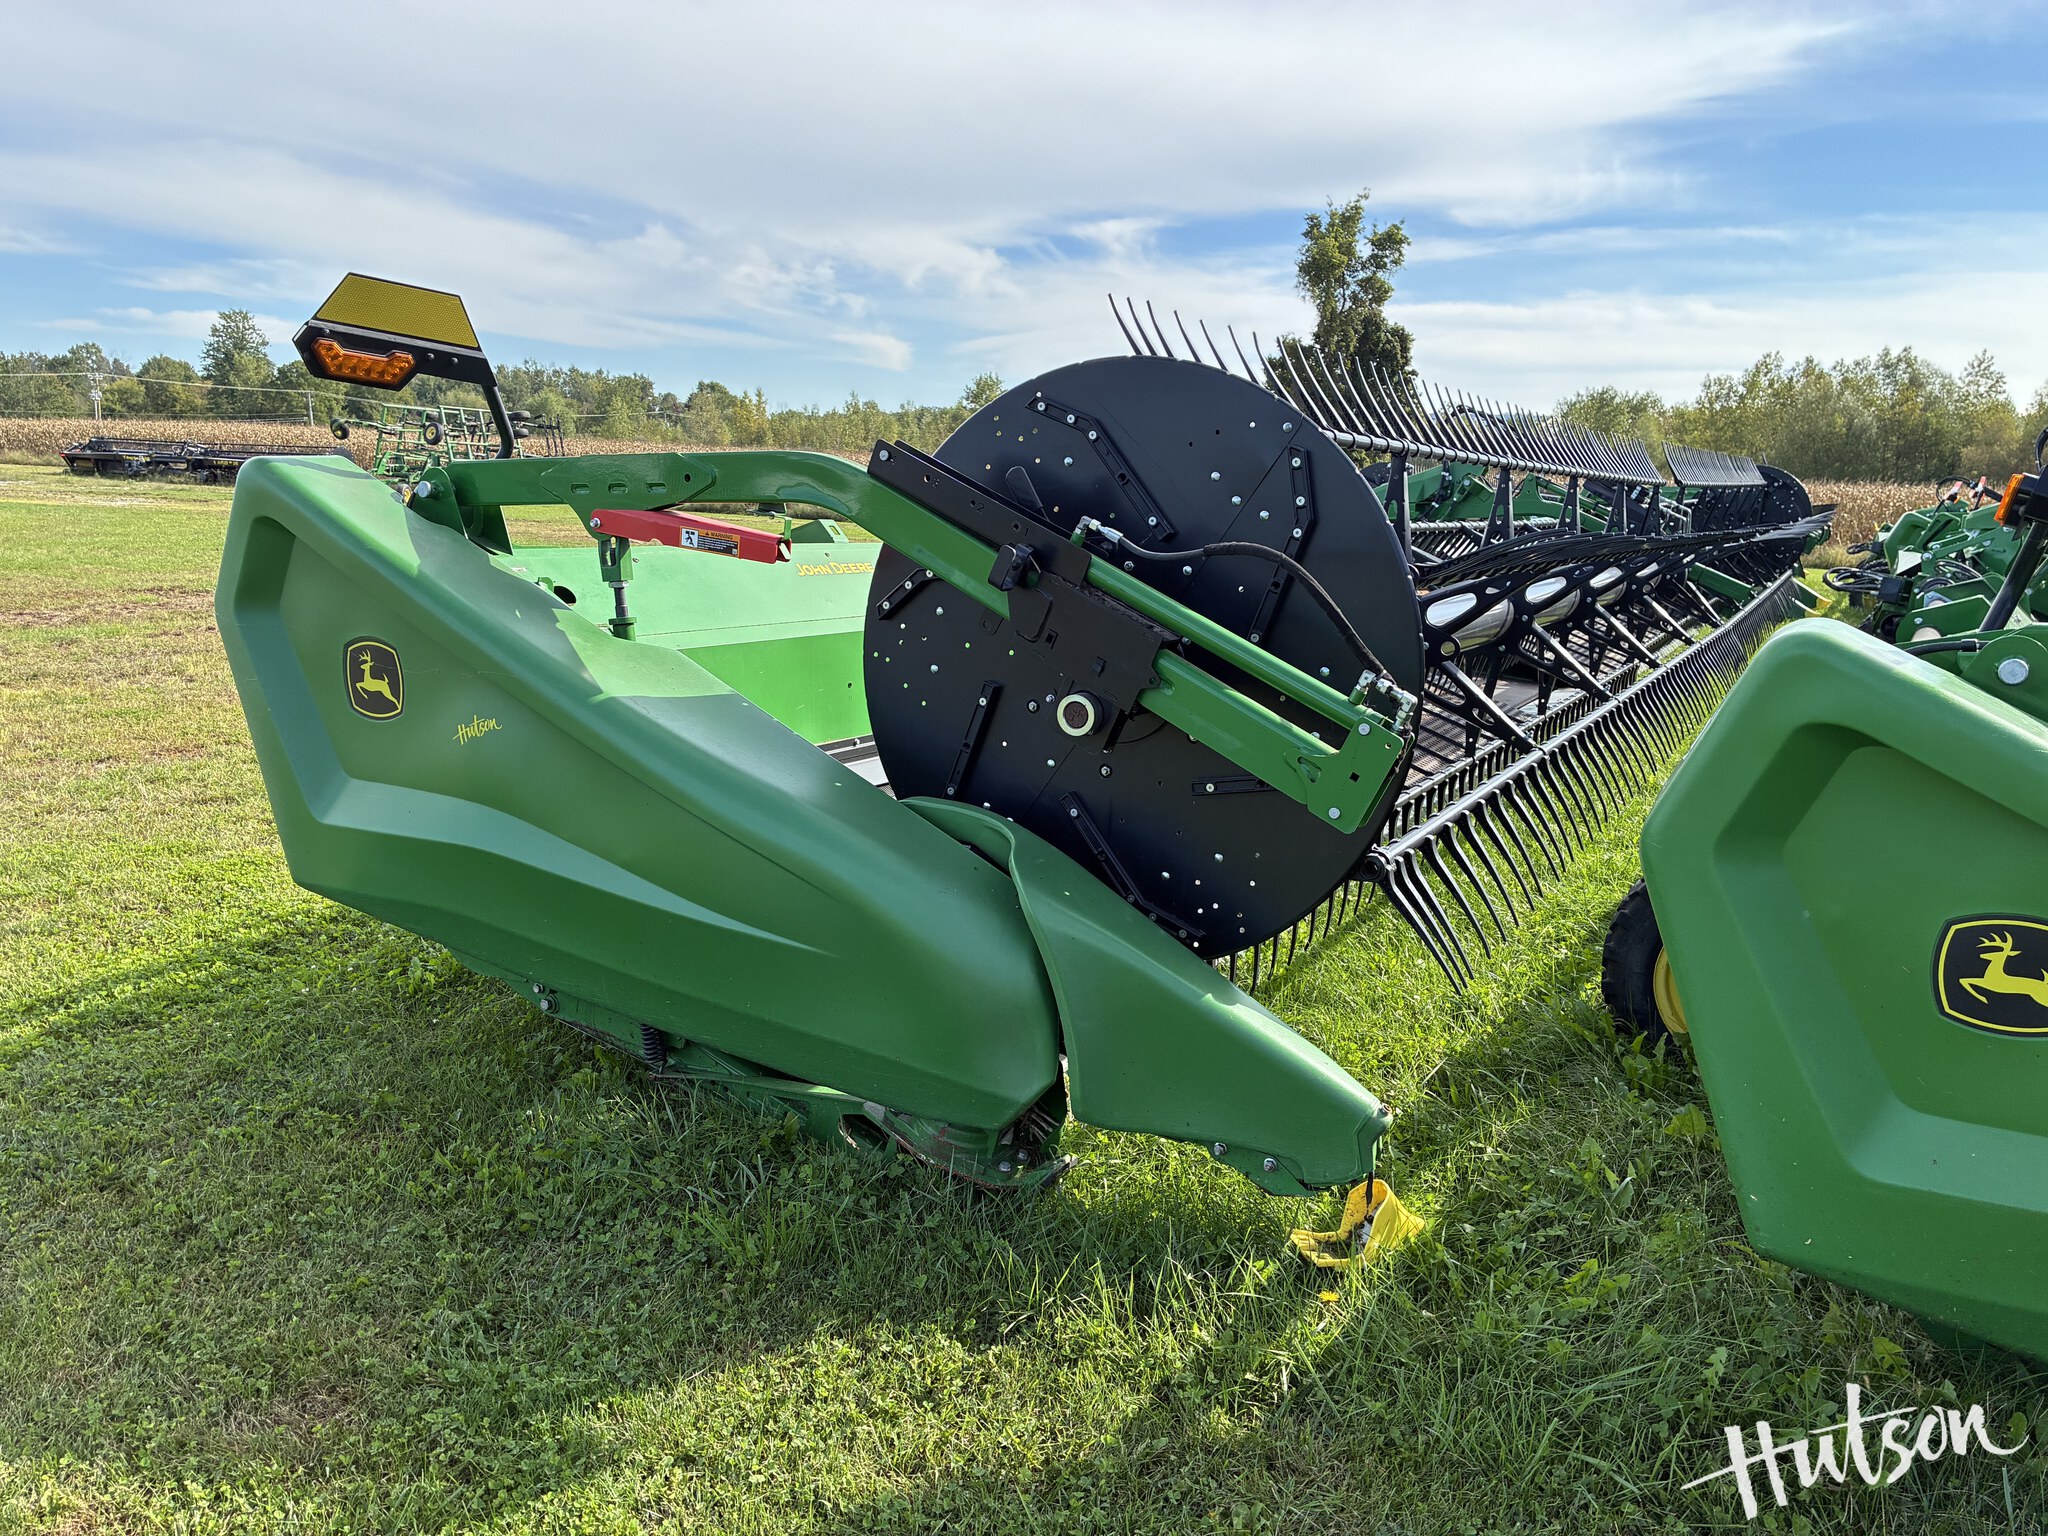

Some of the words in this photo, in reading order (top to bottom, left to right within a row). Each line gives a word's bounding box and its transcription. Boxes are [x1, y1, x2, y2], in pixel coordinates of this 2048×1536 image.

[710, 531, 733, 540] WARNING
[796, 563, 833, 576] JOHN
[829, 561, 874, 574] DEERE
[453, 715, 502, 745] Hutson
